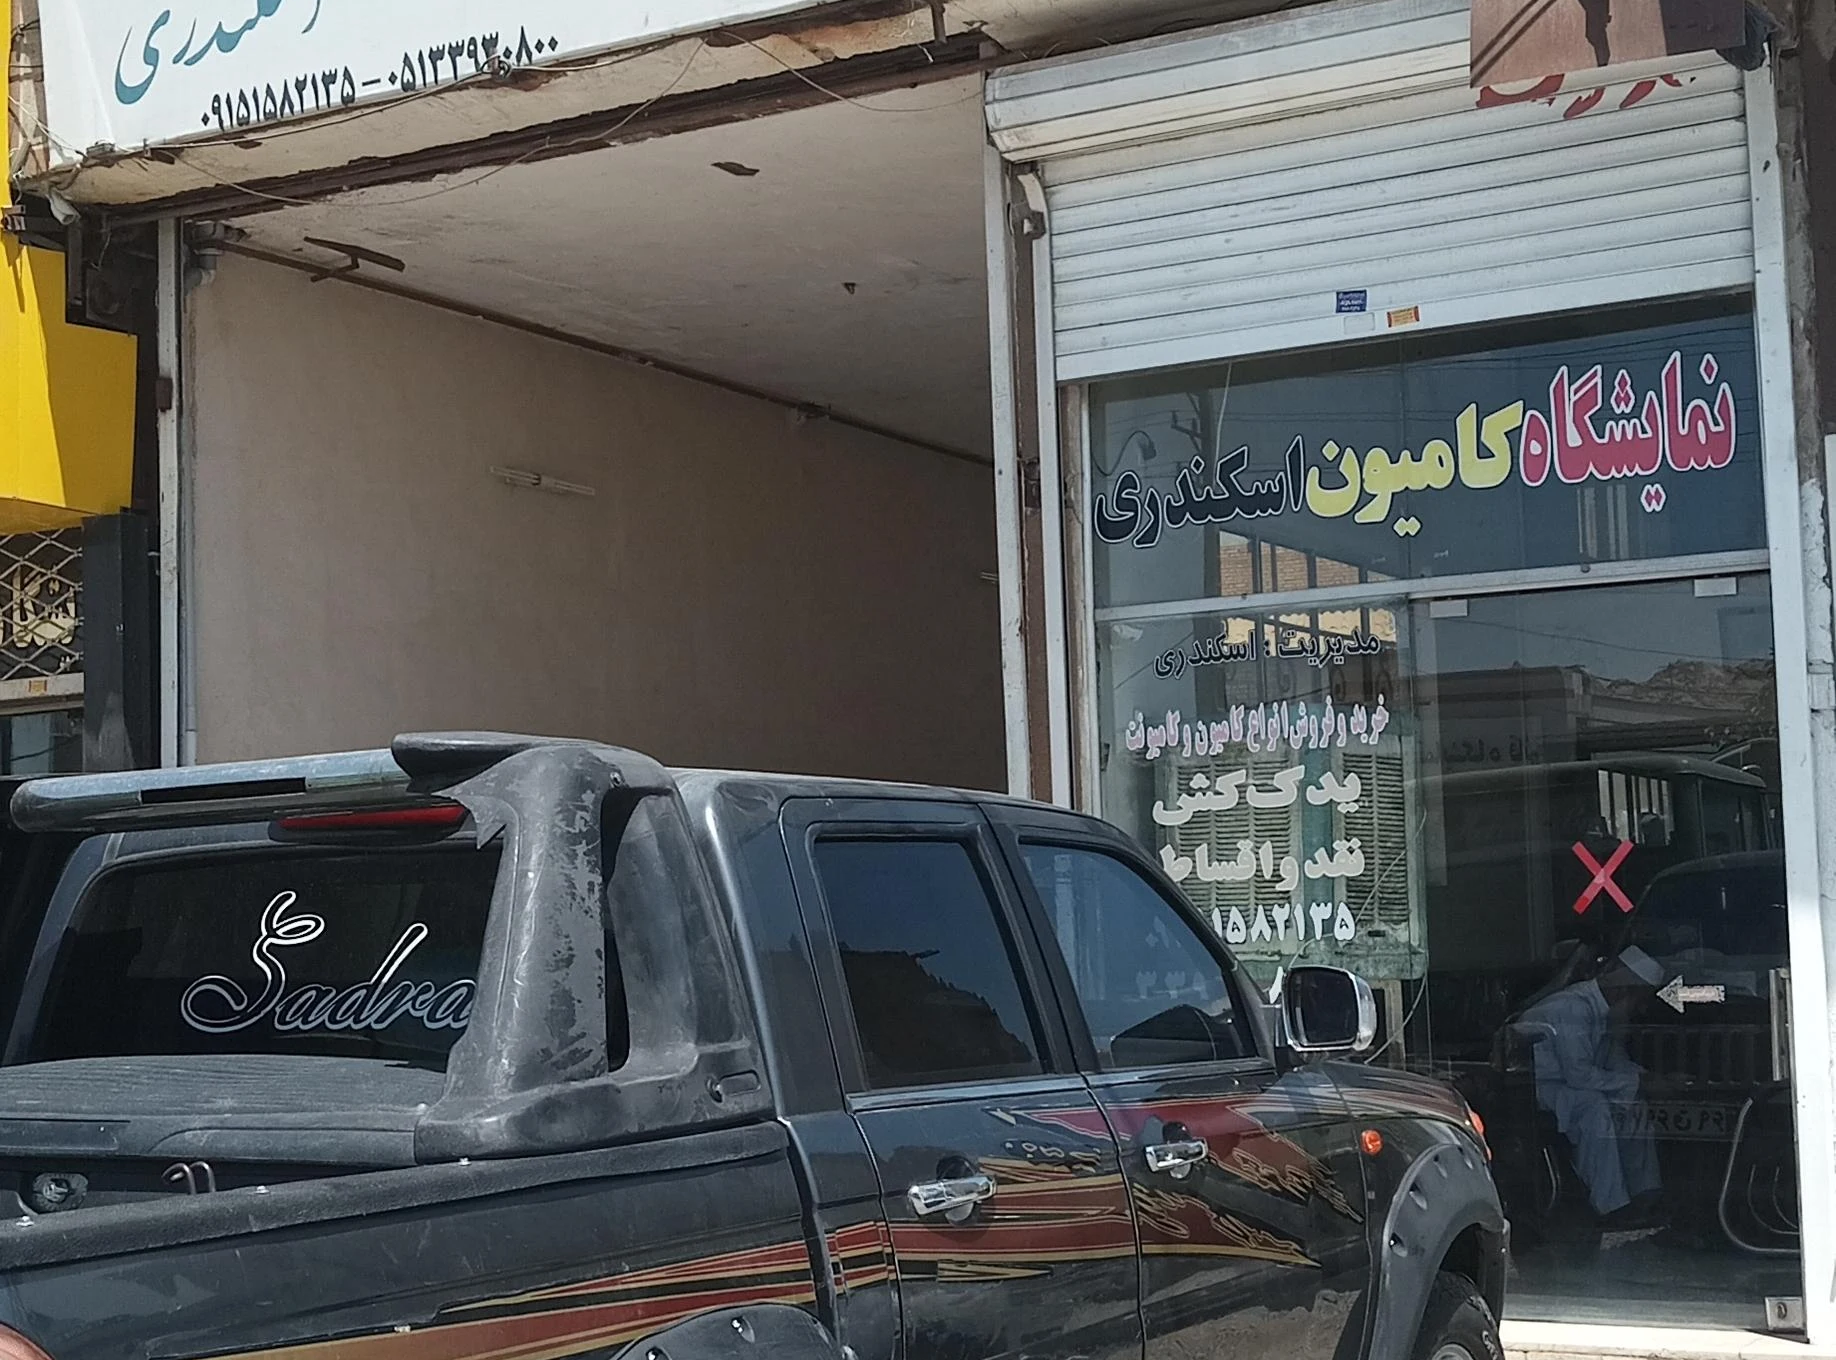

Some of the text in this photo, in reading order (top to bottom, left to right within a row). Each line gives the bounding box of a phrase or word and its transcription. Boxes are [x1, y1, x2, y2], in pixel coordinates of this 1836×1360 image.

[1094, 350, 1737, 549] نمایشگاه کامیون اسکندری
[1153, 629, 1257, 680] اسکندری
[1278, 626, 1381, 668] مدیریت
[1195, 703, 1245, 756] کامیون
[1246, 700, 1289, 752] انواع
[1289, 694, 1335, 750] فروش
[1349, 693, 1390, 745] خرید
[1159, 837, 1366, 892] نقد و اقساط
[181, 890, 476, 1034] Sadra
